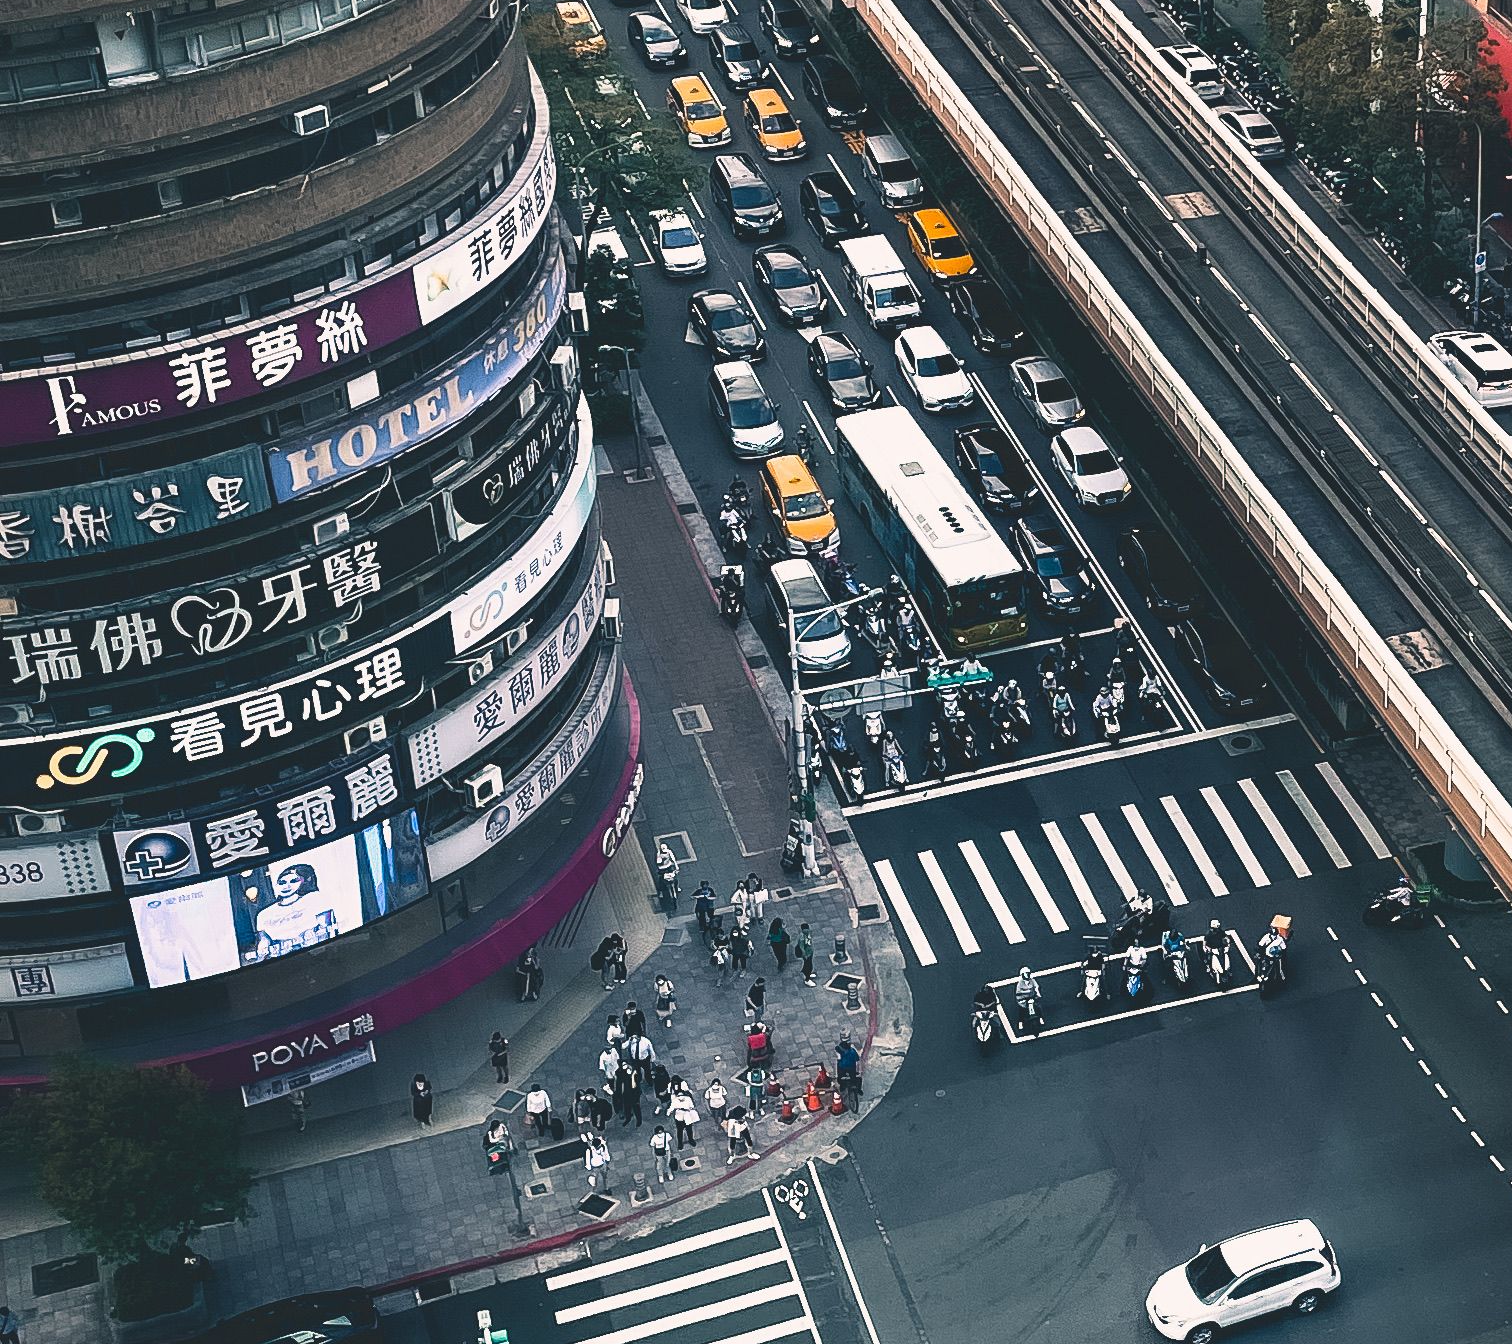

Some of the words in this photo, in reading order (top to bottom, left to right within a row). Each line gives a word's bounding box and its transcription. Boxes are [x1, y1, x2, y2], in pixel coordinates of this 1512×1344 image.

[168, 297, 369, 410] 菲夢絲
[284, 373, 475, 493] HOTEL
[2, 611, 164, 686] 瑞佛
[257, 540, 383, 635] 牙醫
[514, 531, 564, 594] 看見心理
[168, 646, 406, 766] 看見心理
[473, 634, 561, 744] 愛爾麗
[204, 751, 396, 869] 愛爾麗
[252, 1033, 329, 1073] POYA
